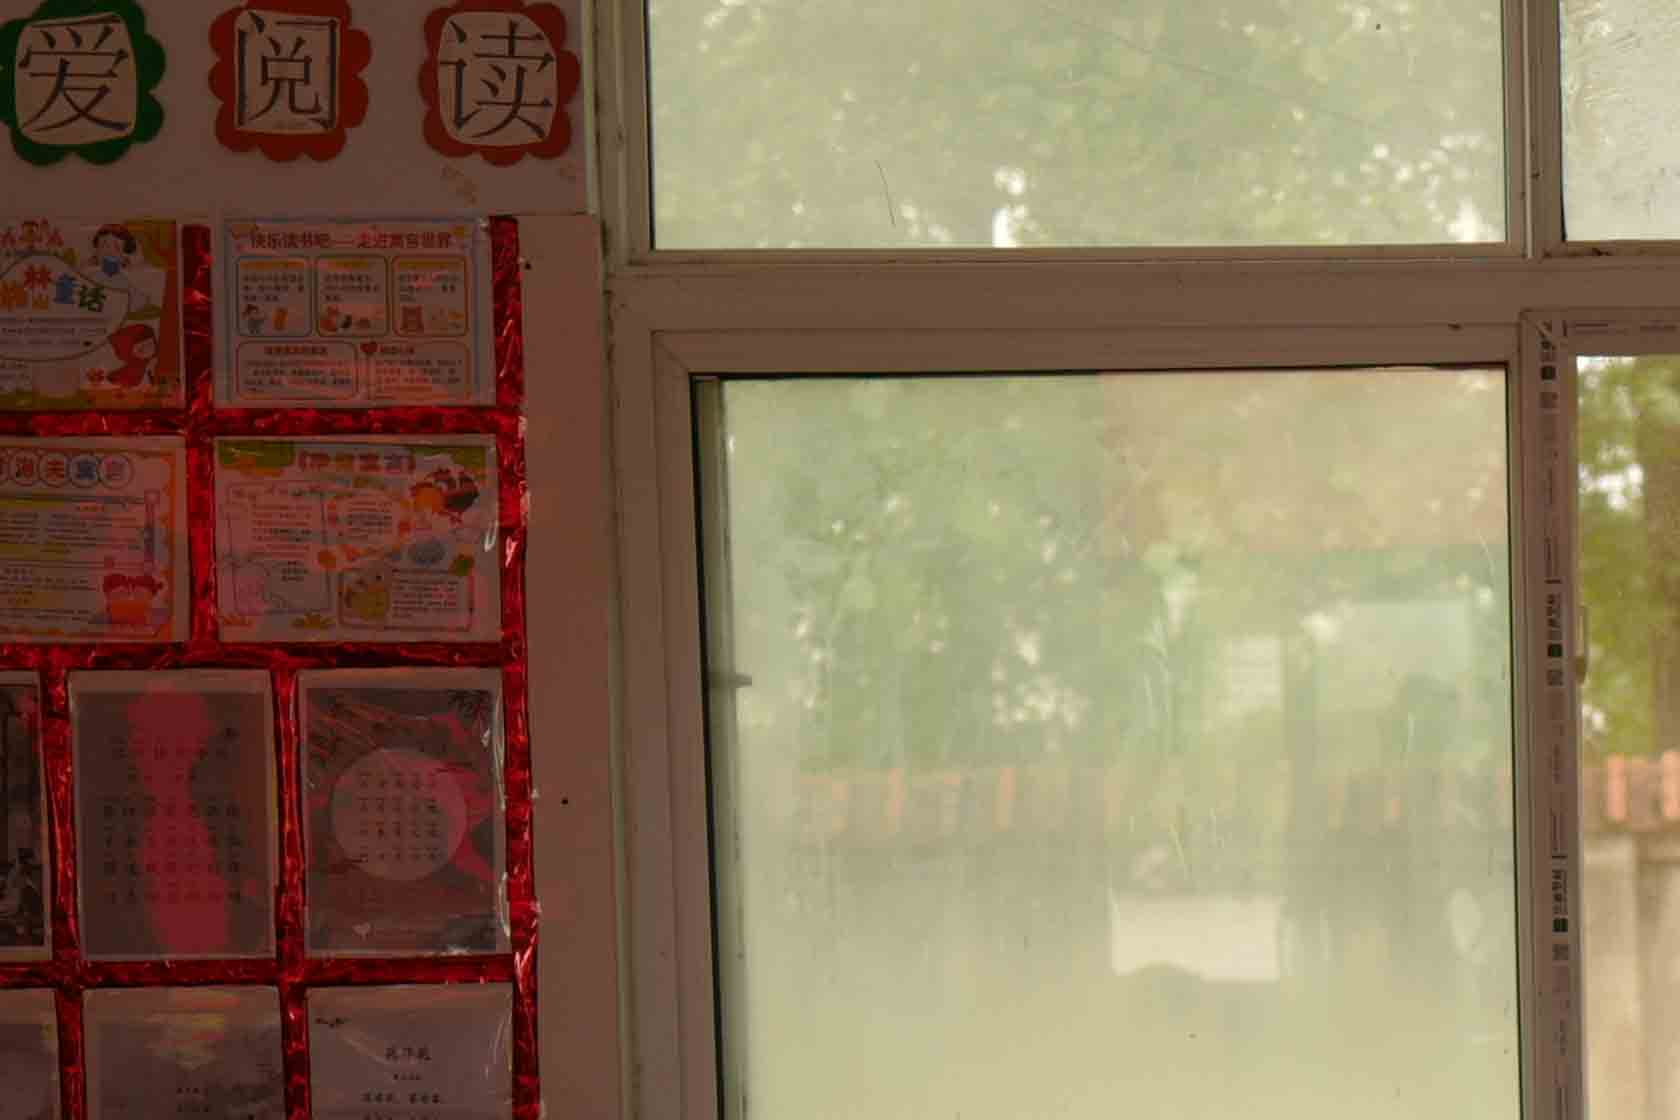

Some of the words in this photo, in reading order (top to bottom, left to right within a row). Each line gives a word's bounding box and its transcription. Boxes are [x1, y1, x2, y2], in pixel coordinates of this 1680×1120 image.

[18, 12, 130, 132] 爱
[236, 10, 339, 130] 阅
[440, 20, 554, 138] 读
